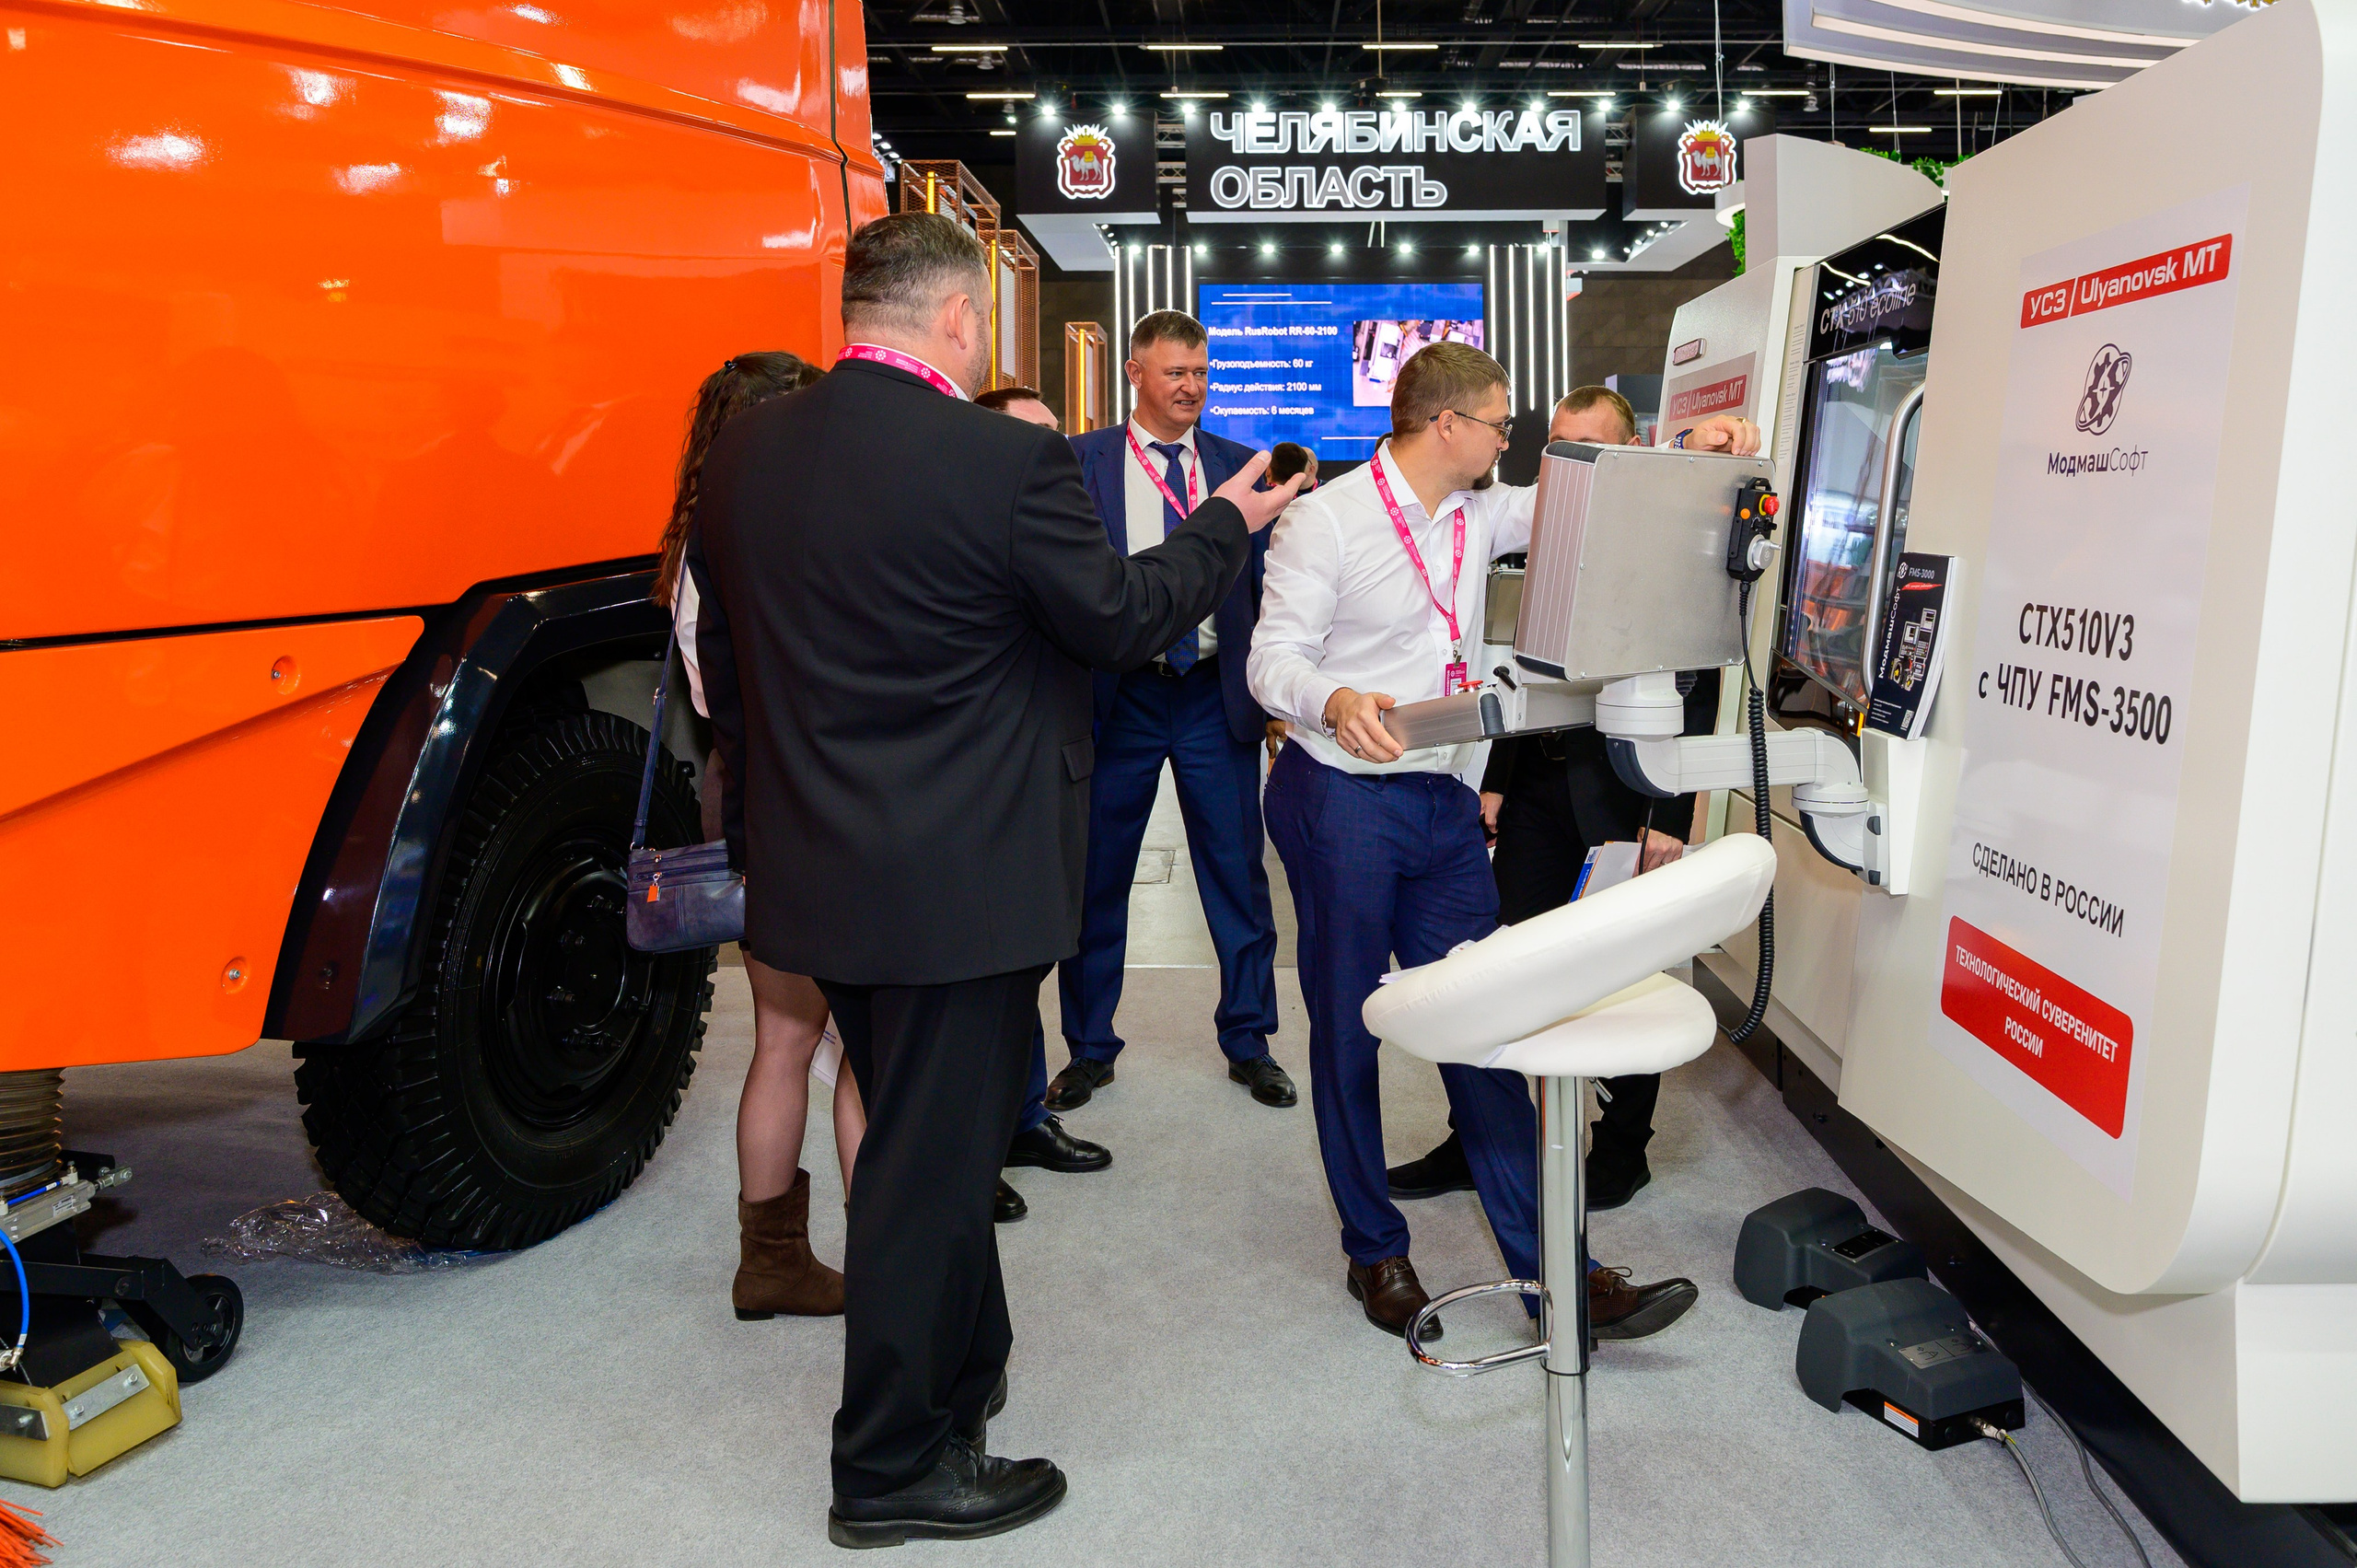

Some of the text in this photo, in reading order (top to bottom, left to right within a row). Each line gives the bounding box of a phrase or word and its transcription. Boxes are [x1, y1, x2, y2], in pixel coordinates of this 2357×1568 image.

[1210, 110, 1582, 154] ЧЕЛЯБИНСКАЯ
[1210, 166, 1448, 208] ОБЛАСТЬ
[2081, 256, 2178, 308] Ulyanovsk
[2182, 242, 2222, 279] MT
[1819, 302, 1847, 335] CTX
[1870, 281, 1916, 319] ecoline
[1208, 326, 1338, 337] Модель RusRobot RR-60-2100
[1293, 358, 1304, 368] 60
[1305, 360, 1314, 368] кг
[1212, 382, 1243, 393] Радиус
[1243, 382, 1285, 393] действия:
[1286, 382, 1307, 391] 2100
[1691, 385, 1728, 413] Ulyanovsk
[1728, 379, 1744, 402] MT
[1213, 406, 1315, 417] Окупаемость: 6 месяцев
[2047, 444, 2149, 477] МодмашСофт
[1909, 567, 1934, 579] FMS-3000
[1878, 586, 1901, 679] МодмашСофт
[2019, 602, 2134, 661] CTX510V3
[1979, 663, 2172, 745] с ЧПУ FMS-3500
[1972, 842, 2124, 937] СДЕЛАНО В РОССИИ
[1956, 945, 2119, 1063] ТЕХНОЛОГИЧЕСКИЙ СУВЕРЕНИТЕТ
[2004, 1016, 2044, 1059] РОССИИ
